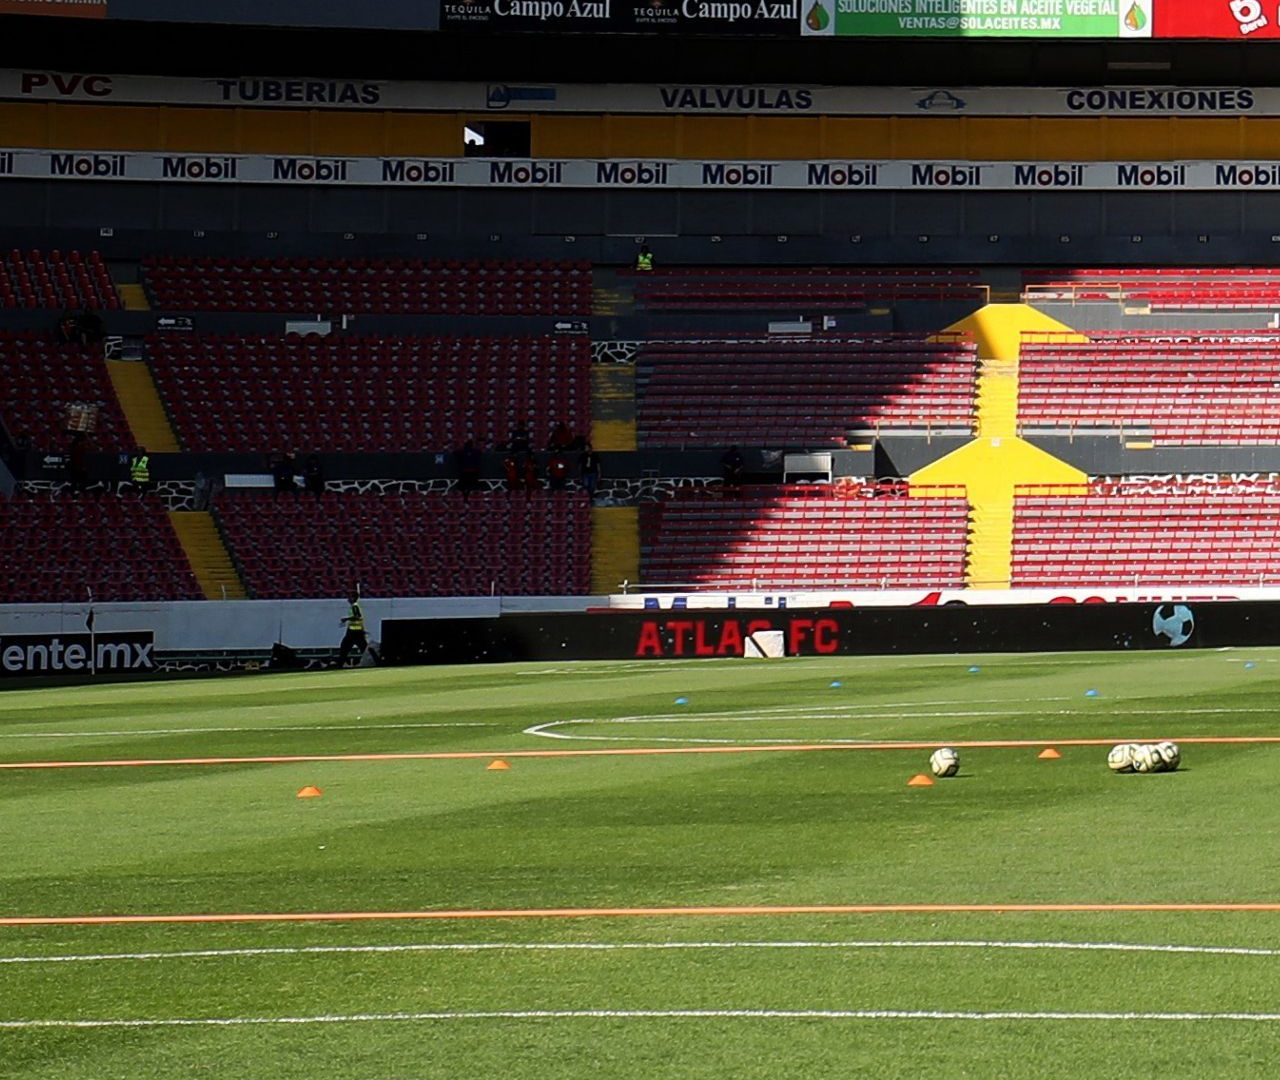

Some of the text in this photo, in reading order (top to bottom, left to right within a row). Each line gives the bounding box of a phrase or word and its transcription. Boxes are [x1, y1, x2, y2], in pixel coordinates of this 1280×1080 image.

[444, 4, 492, 14] TEQUILA
[633, 8, 679, 16] TEQUILA
[915, 0, 999, 15] INTELIGENTES
[1001, 0, 1017, 15] EN
[1020, 0, 1064, 15] ACEITE
[1067, 0, 1118, 16] VEGETAL
[898, 16, 1061, 31] VENTAS@SOLACEITES.MX
[21, 73, 112, 96] PVC
[218, 80, 380, 104] TUBERIAS
[660, 89, 812, 109] VALVULAS
[1067, 90, 1253, 110] CONEXIONES
[50, 155, 124, 176] Mobil
[162, 156, 236, 178] Mobil
[273, 159, 346, 181] Mobil
[382, 160, 454, 182] Mobil
[490, 161, 562, 184] Mobil
[596, 163, 667, 185] Mobil
[702, 163, 772, 185] Mobil
[807, 163, 876, 186] Mobil
[911, 164, 980, 186] Mobil
[1014, 164, 1083, 186] Mobil
[1117, 164, 1185, 186] Mobil
[789, 619, 840, 654] FC
